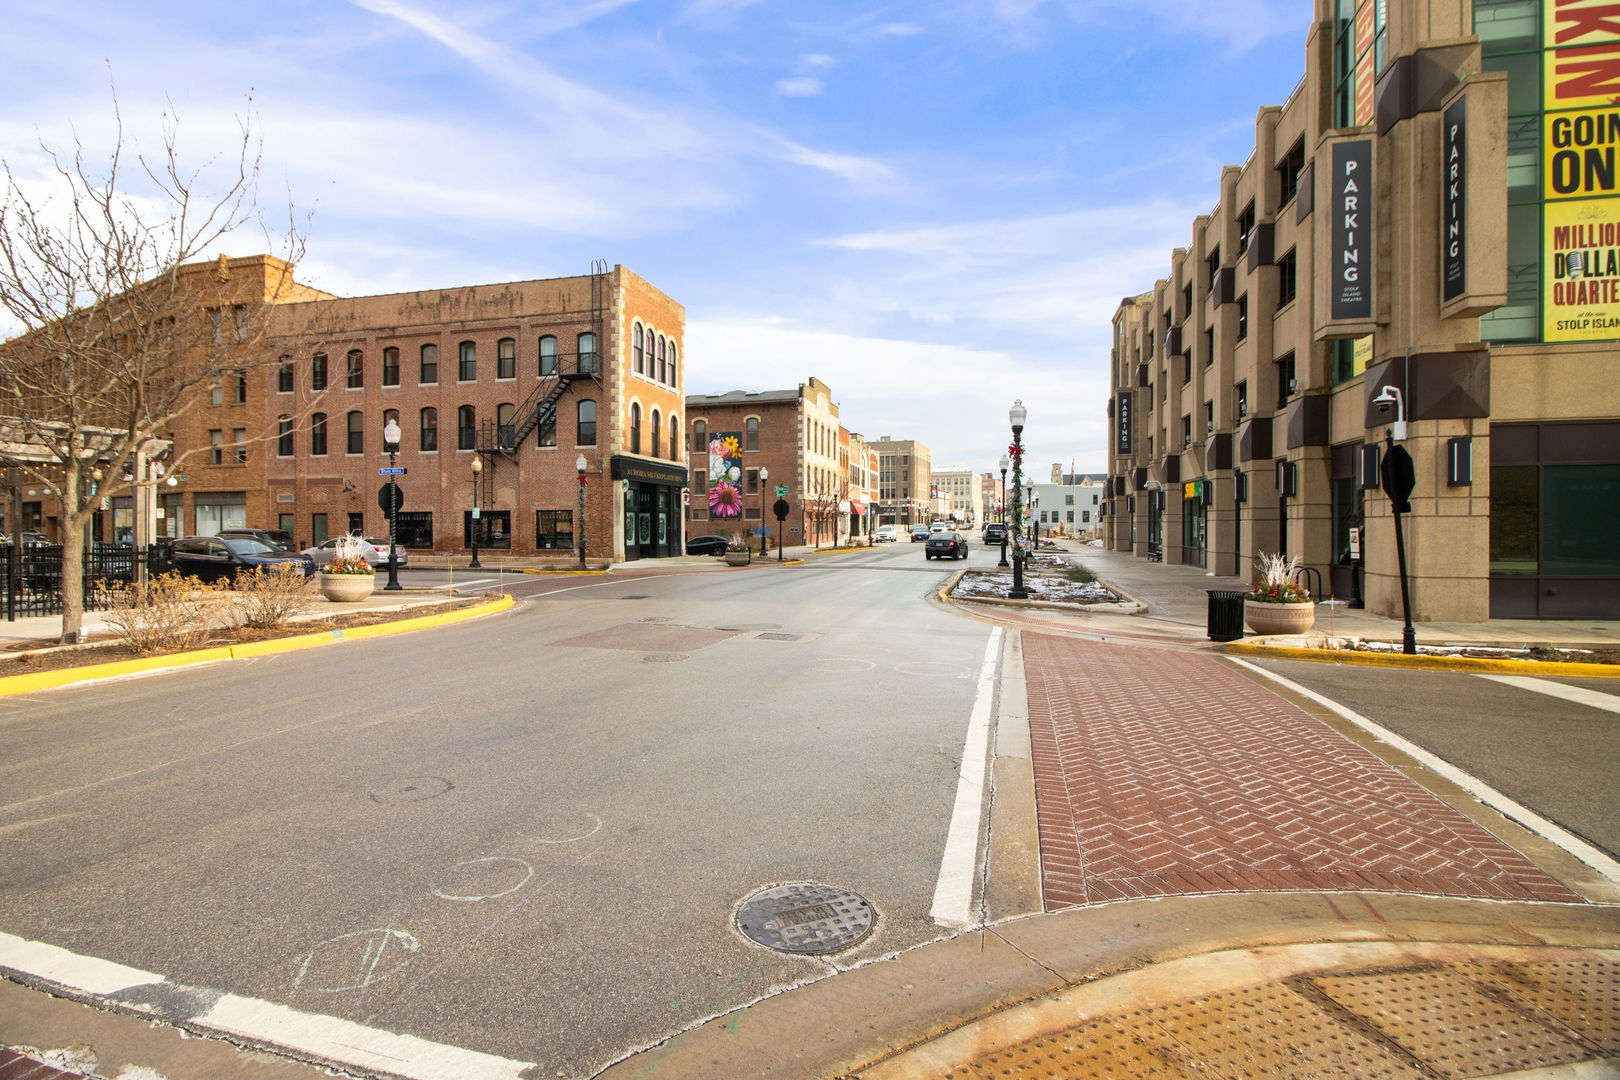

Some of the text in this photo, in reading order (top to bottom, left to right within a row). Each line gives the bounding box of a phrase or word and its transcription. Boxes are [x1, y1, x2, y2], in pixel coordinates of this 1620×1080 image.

[1552, 147, 1615, 194] ON
[1450, 124, 1458, 257] PARKING
[1344, 161, 1358, 281] PARKING
[1554, 222, 1620, 250] MILLIO
[1554, 249, 1620, 279] DOLLA
[1557, 319, 1590, 331] STOLP
